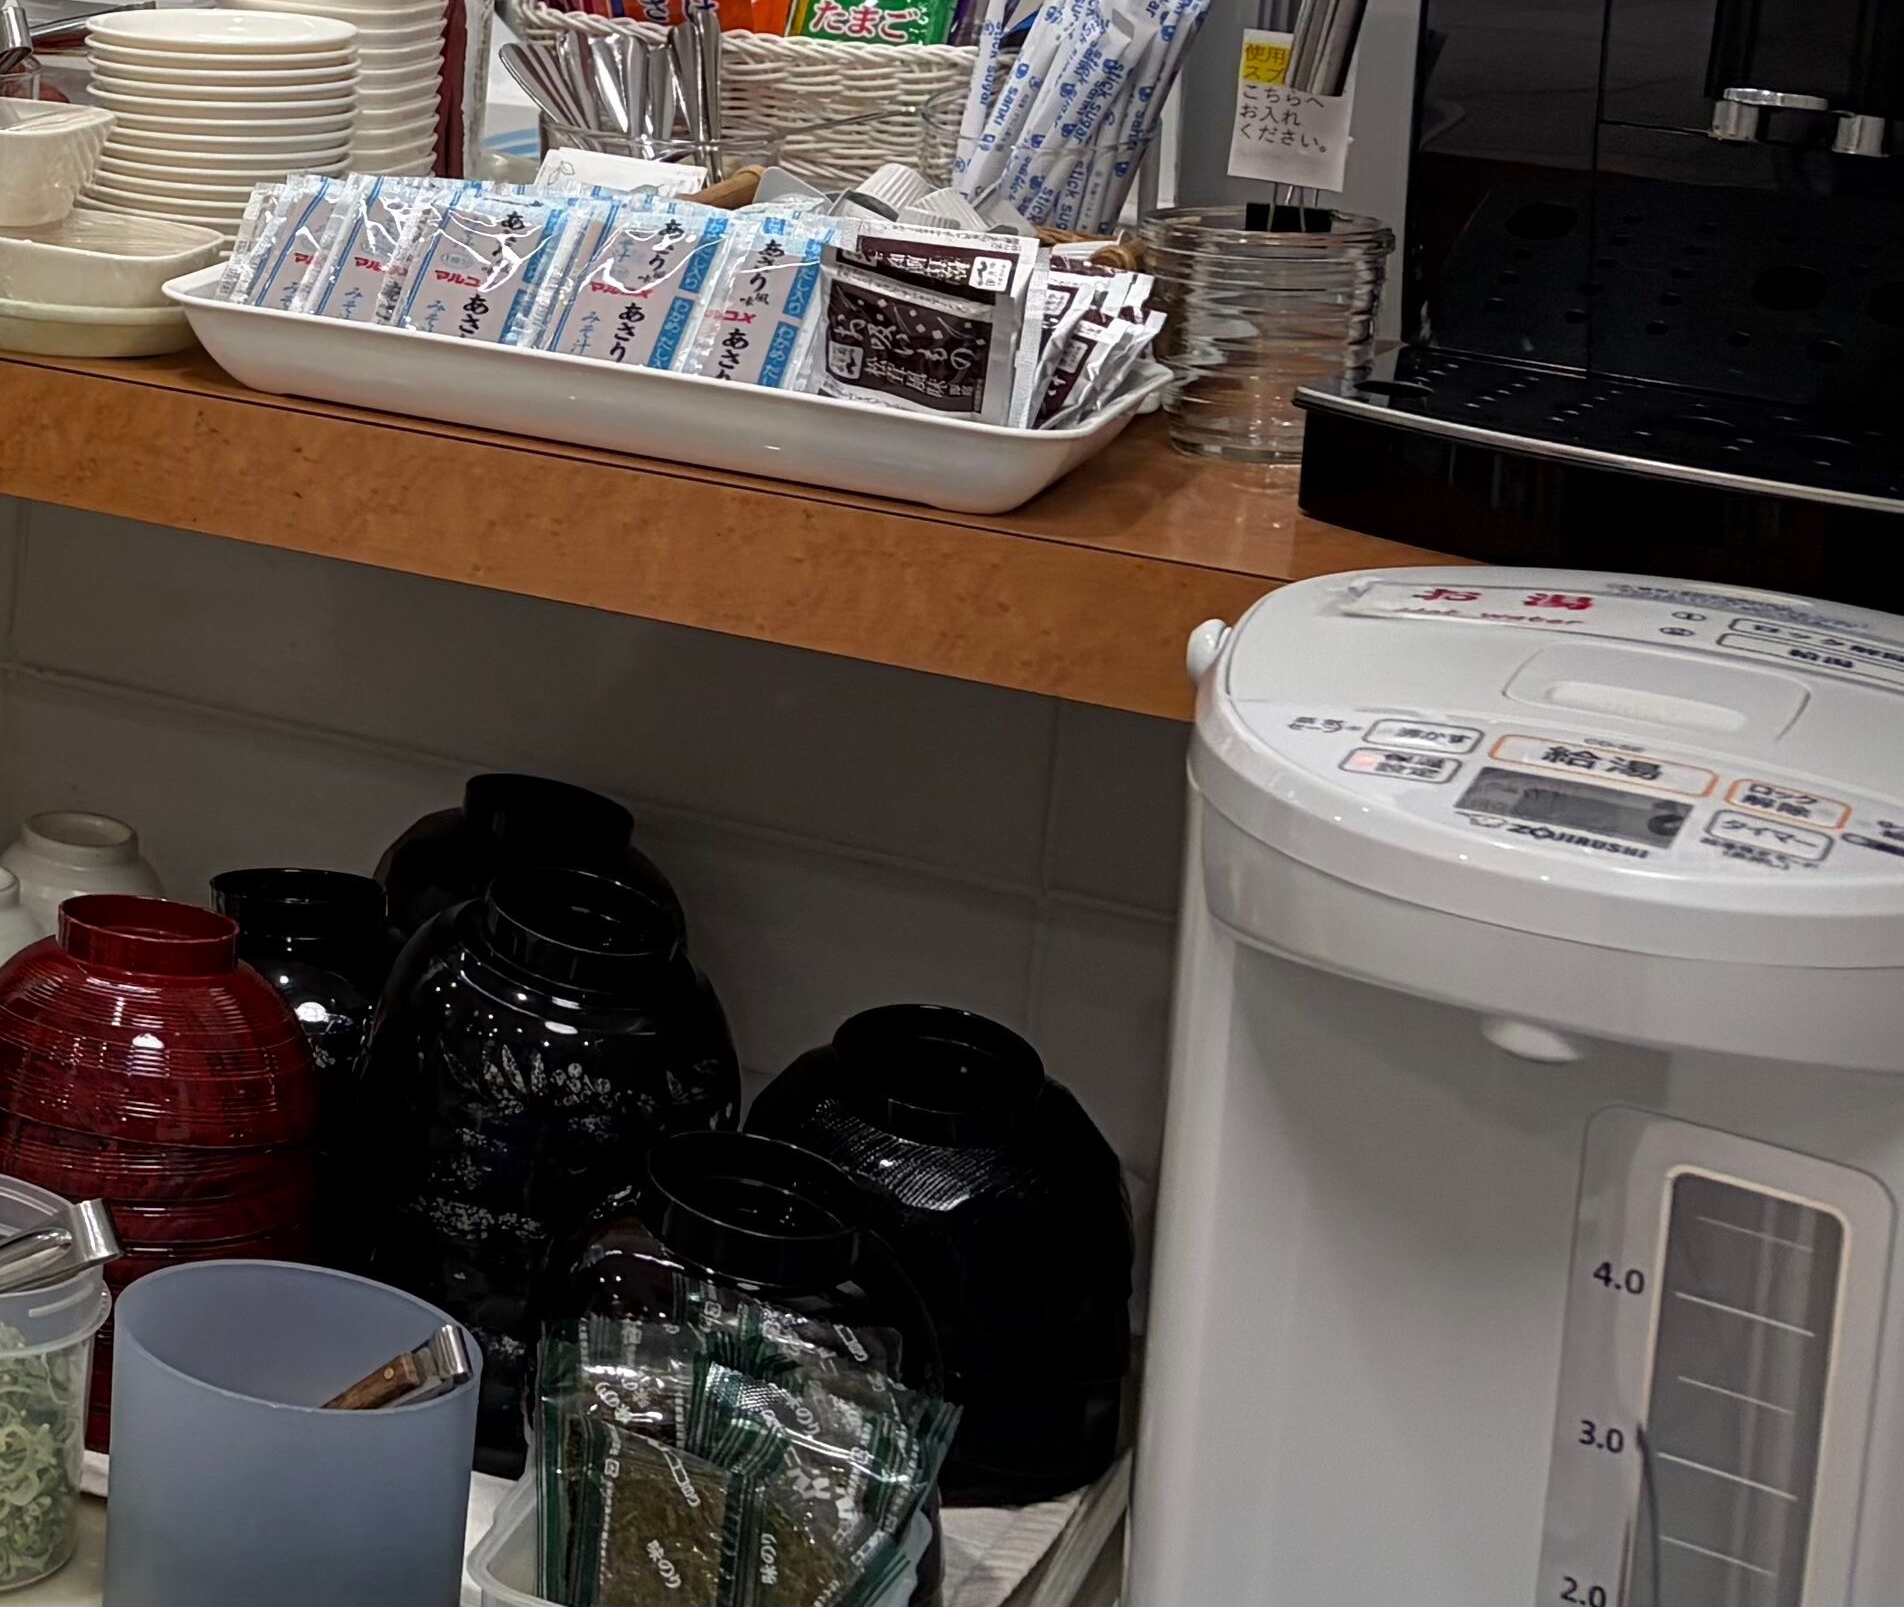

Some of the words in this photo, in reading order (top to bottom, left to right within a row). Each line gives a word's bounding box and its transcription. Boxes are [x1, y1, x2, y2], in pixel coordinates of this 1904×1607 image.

[1242, 84, 1325, 109] こちらへ
[1239, 104, 1301, 127] お入れ
[1239, 122, 1328, 154] ください。
[609, 302, 646, 363] あさり
[1541, 744, 1663, 782] 給湯
[1747, 783, 1820, 806] ロック
[1506, 823, 1650, 861] ZOJIRUSHI
[1718, 818, 1821, 849] タイマー
[1592, 1261, 1645, 1295] 4.0
[1578, 1419, 1625, 1454] 3.0
[646, 1538, 682, 1589] 味のり
[1559, 1576, 1608, 1607] 2.0
